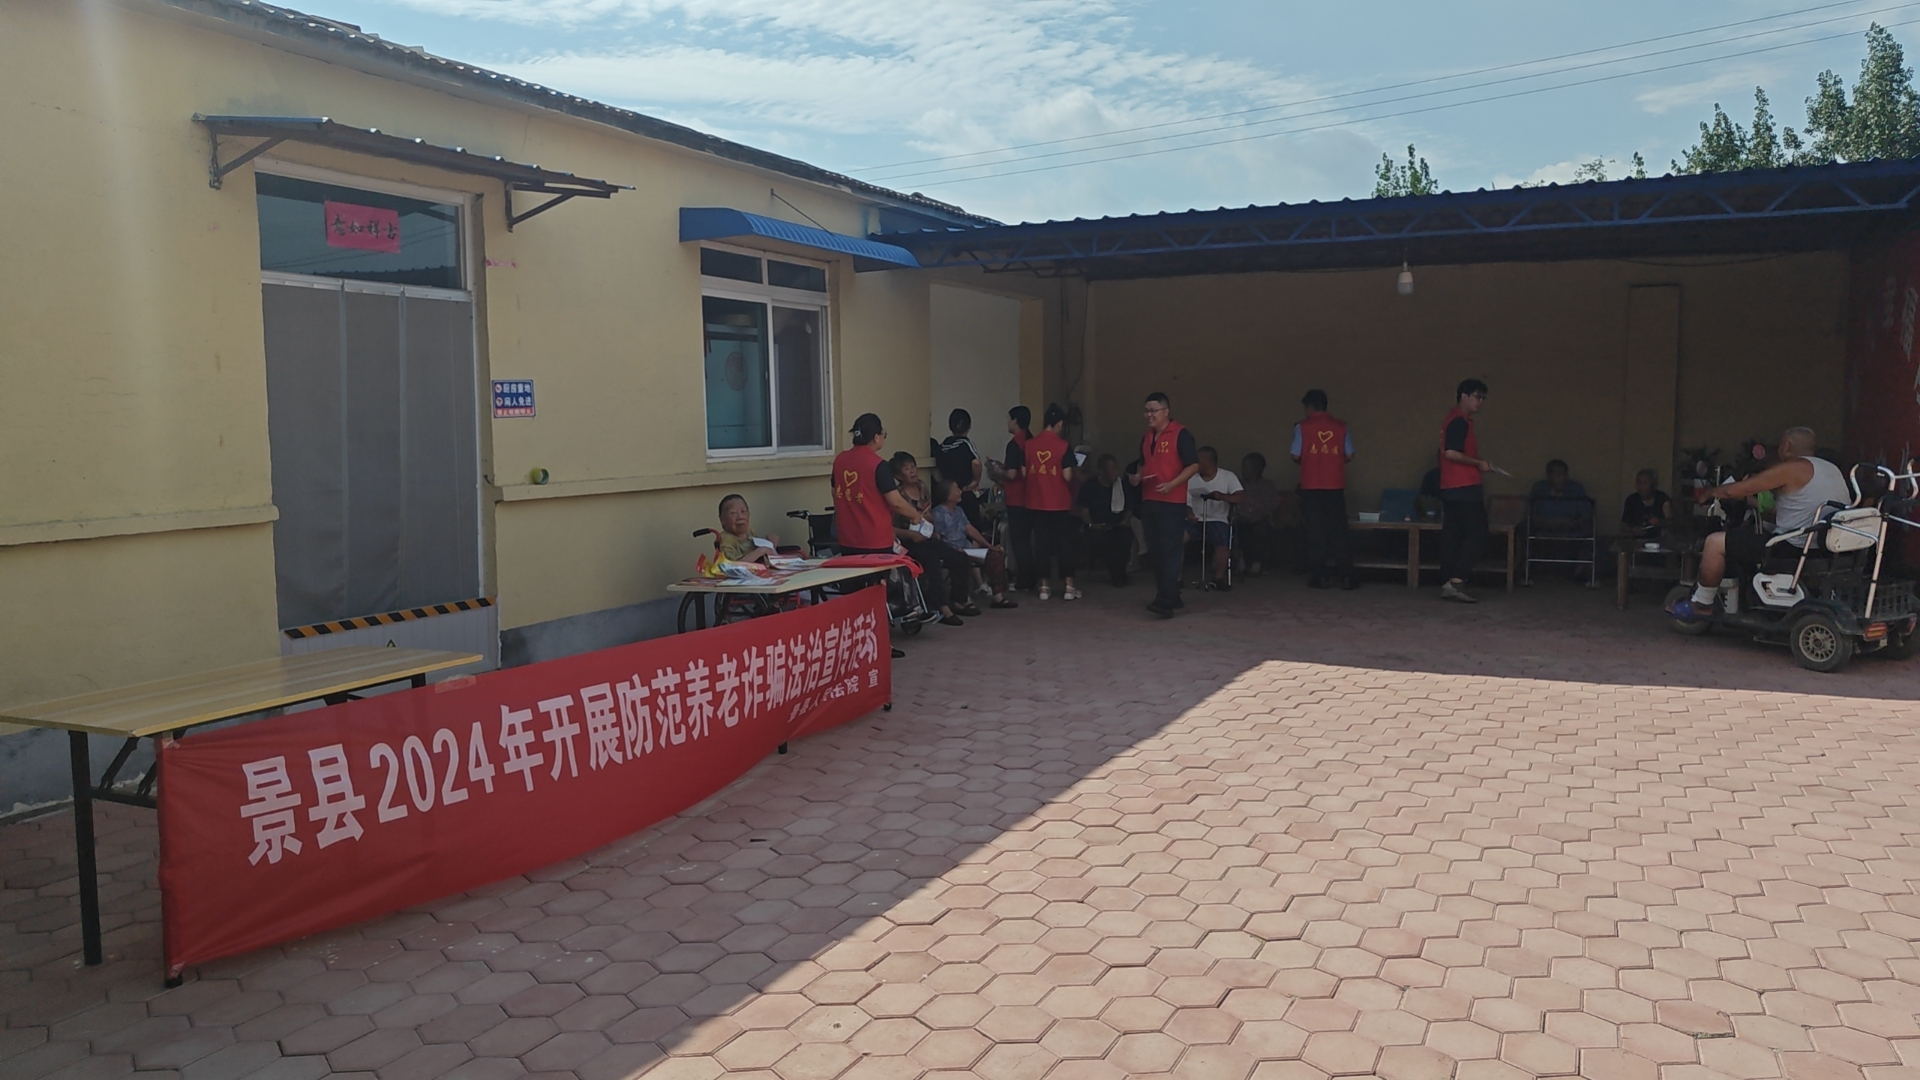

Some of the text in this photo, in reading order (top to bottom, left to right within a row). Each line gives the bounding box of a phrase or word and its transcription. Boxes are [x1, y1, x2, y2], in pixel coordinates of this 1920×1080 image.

[240, 608, 878, 866] 景县2024年开展防范养老诈骗法治宣传活动
